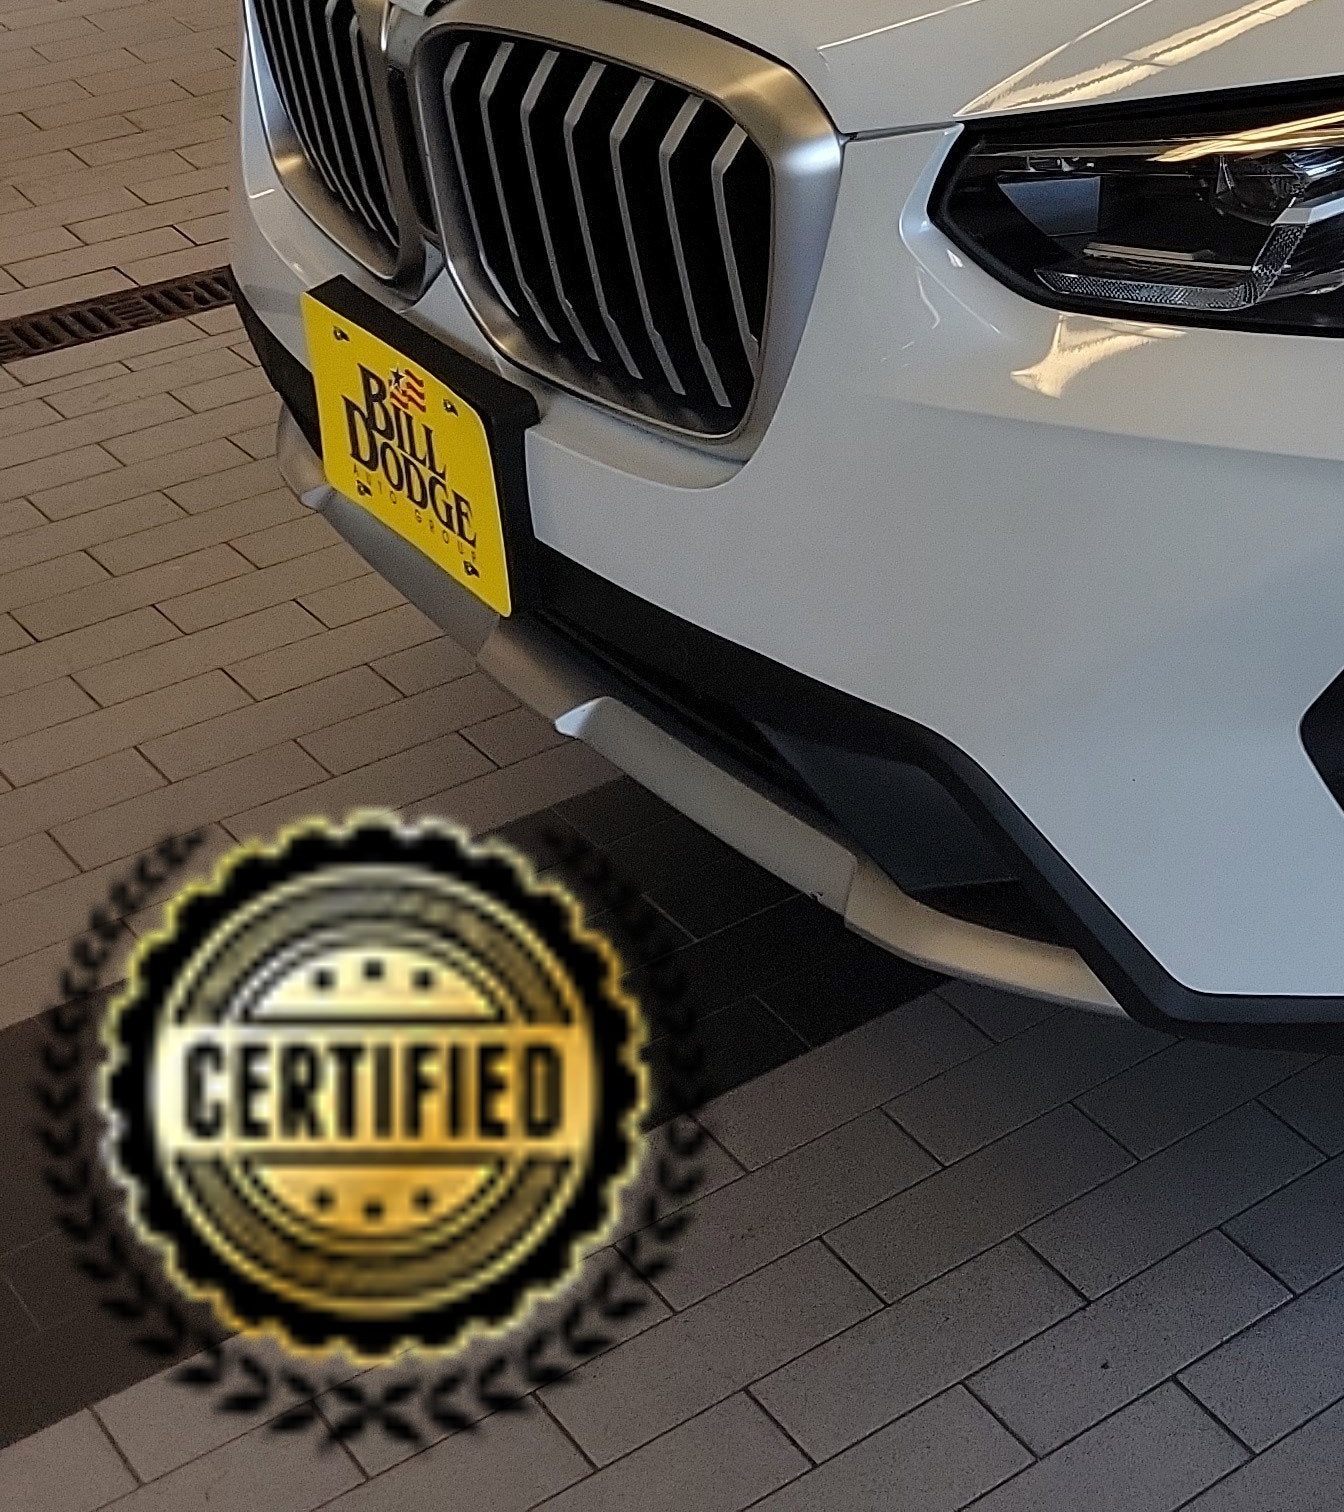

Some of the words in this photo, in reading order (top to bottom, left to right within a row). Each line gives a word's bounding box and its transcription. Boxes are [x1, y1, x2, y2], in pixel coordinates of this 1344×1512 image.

[341, 394, 477, 548] DODGE
[357, 362, 447, 481] BILL
[353, 463, 397, 505] AUTO
[414, 508, 477, 561] GROUP
